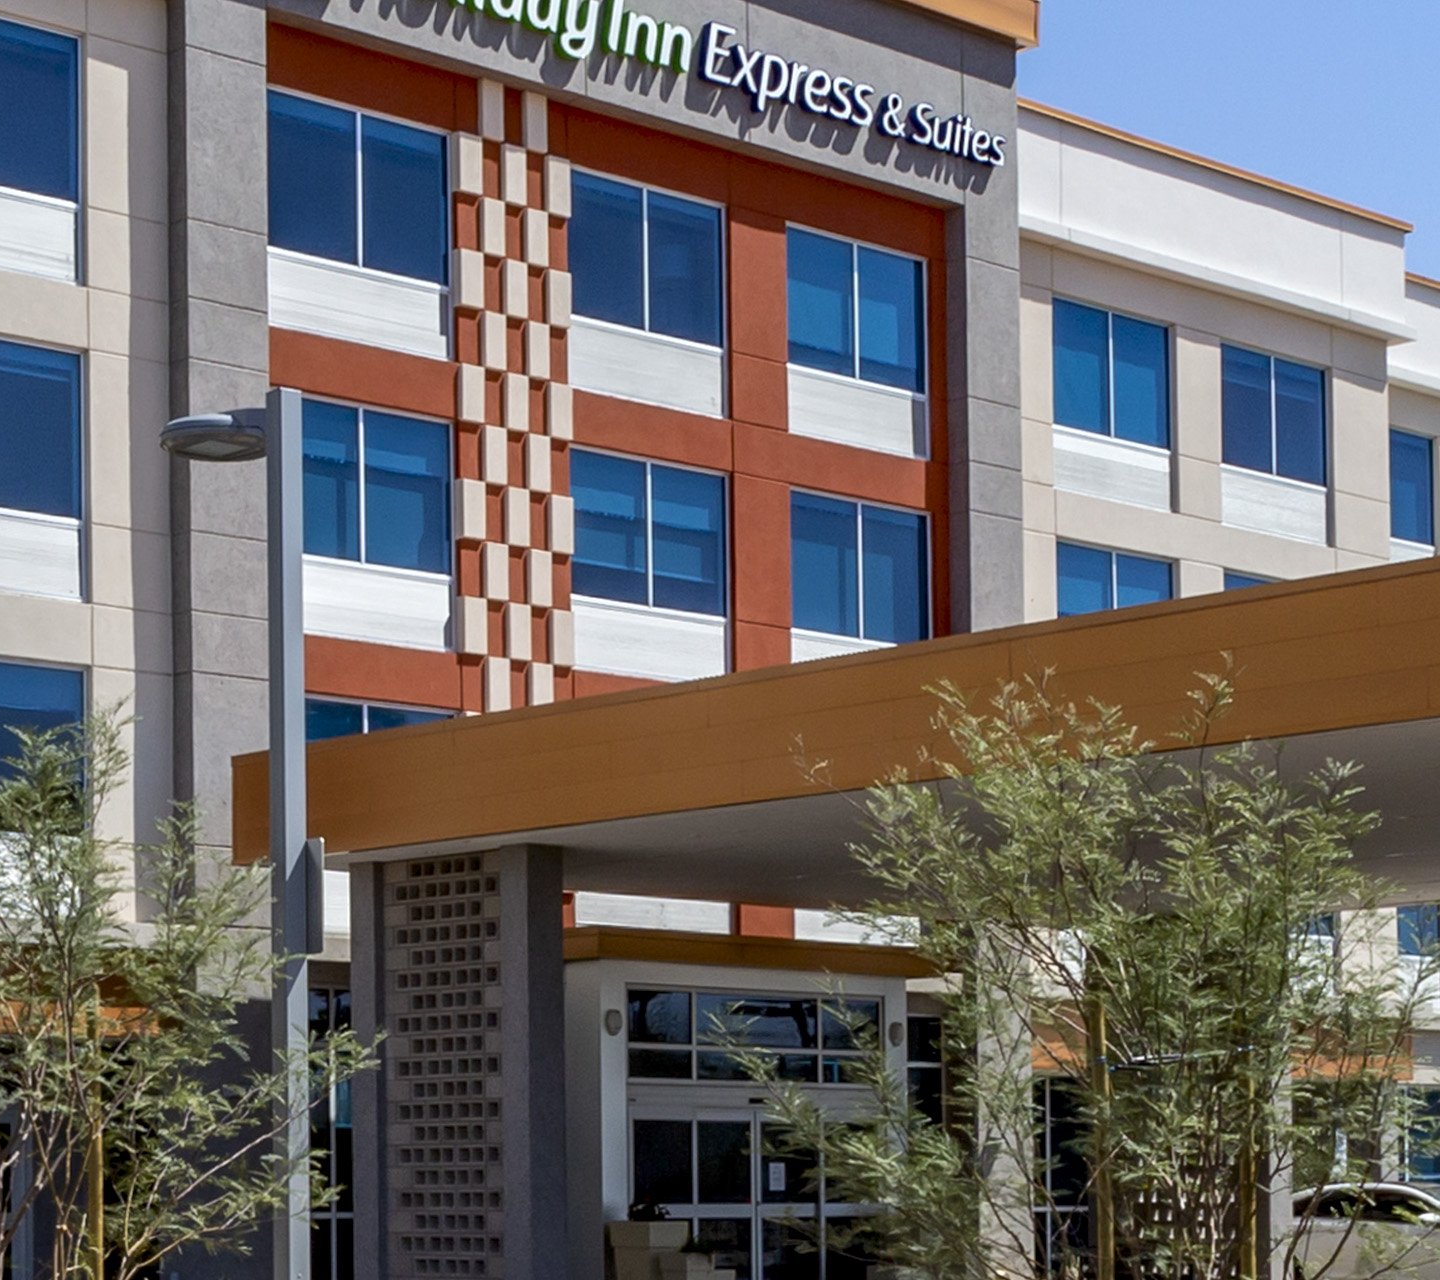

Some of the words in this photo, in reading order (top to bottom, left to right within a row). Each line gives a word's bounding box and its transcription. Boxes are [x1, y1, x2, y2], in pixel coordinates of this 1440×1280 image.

[702, 21, 875, 128] Express
[881, 92, 907, 138] &
[911, 102, 1008, 167] Suites
